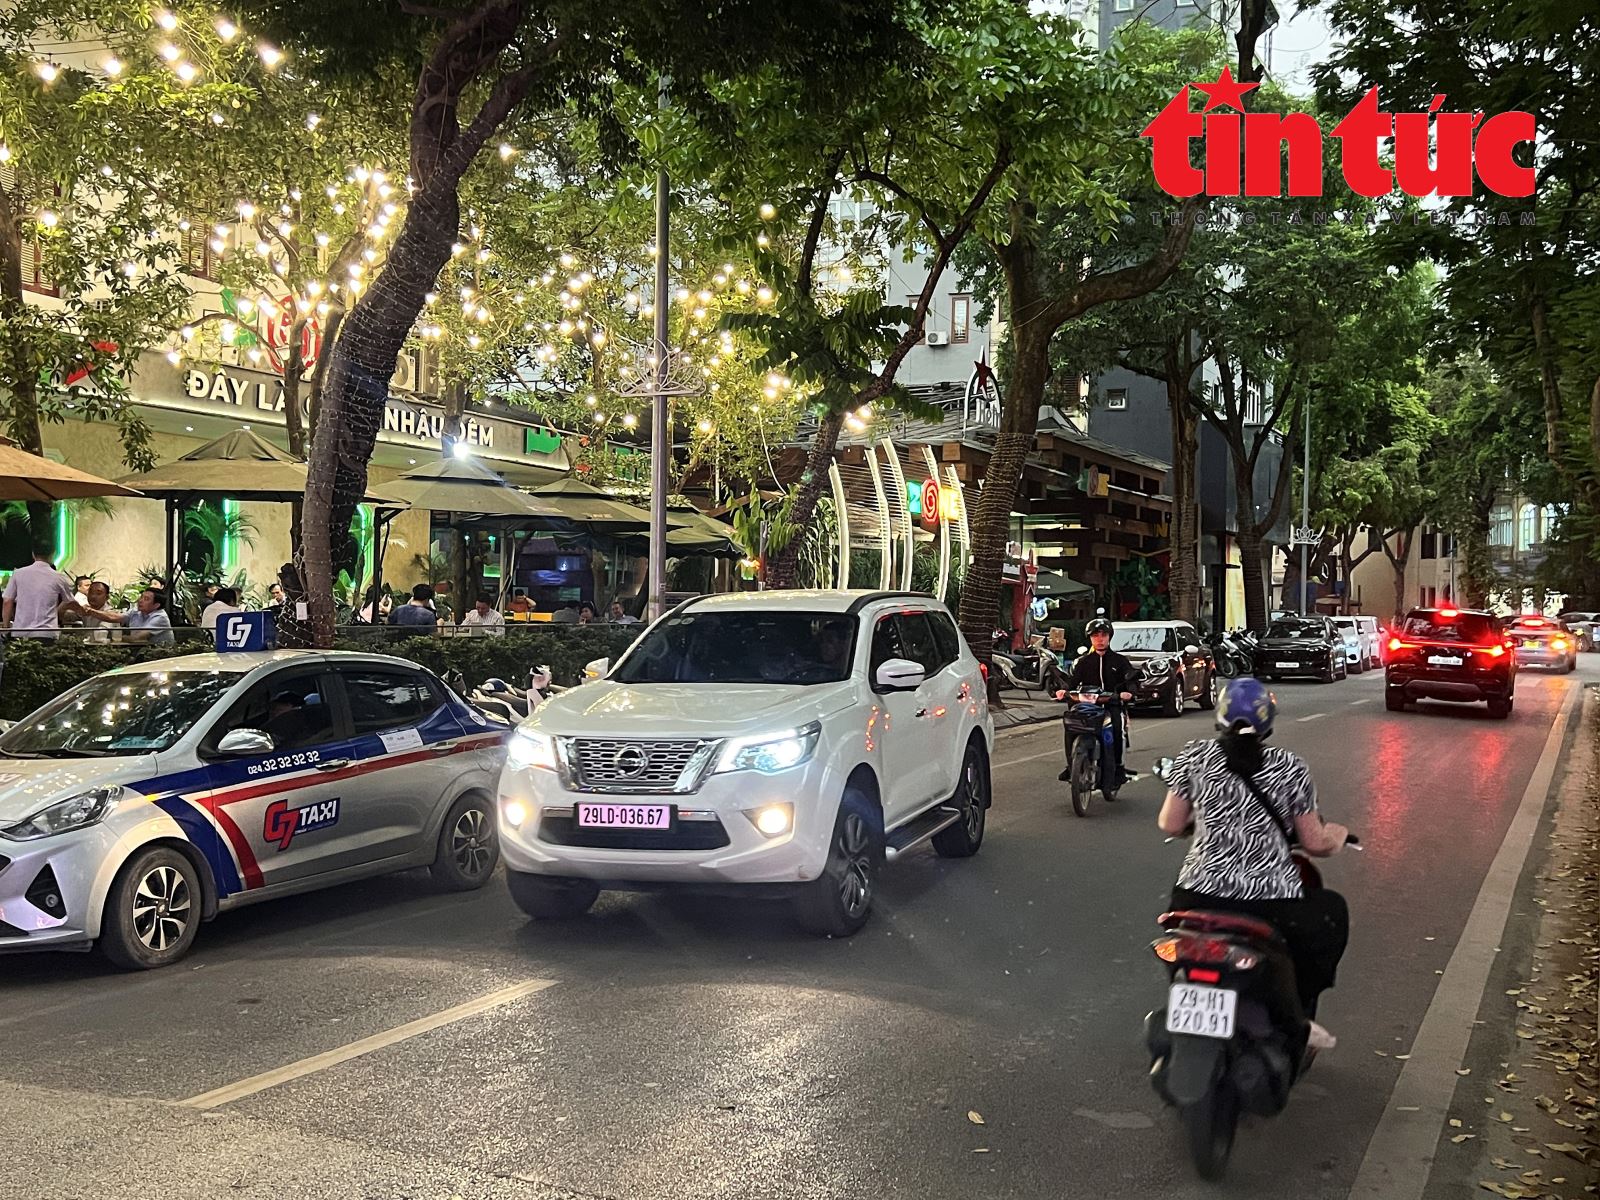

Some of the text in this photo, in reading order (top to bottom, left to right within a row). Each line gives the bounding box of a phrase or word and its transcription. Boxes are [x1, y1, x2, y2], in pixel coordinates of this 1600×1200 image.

[187, 368, 249, 405] ĐÂY
[384, 406, 445, 442] NHẬU
[226, 616, 252, 648] G7
[263, 798, 337, 852] G7 TAXI
[583, 807, 664, 826] 29LD-036.67
